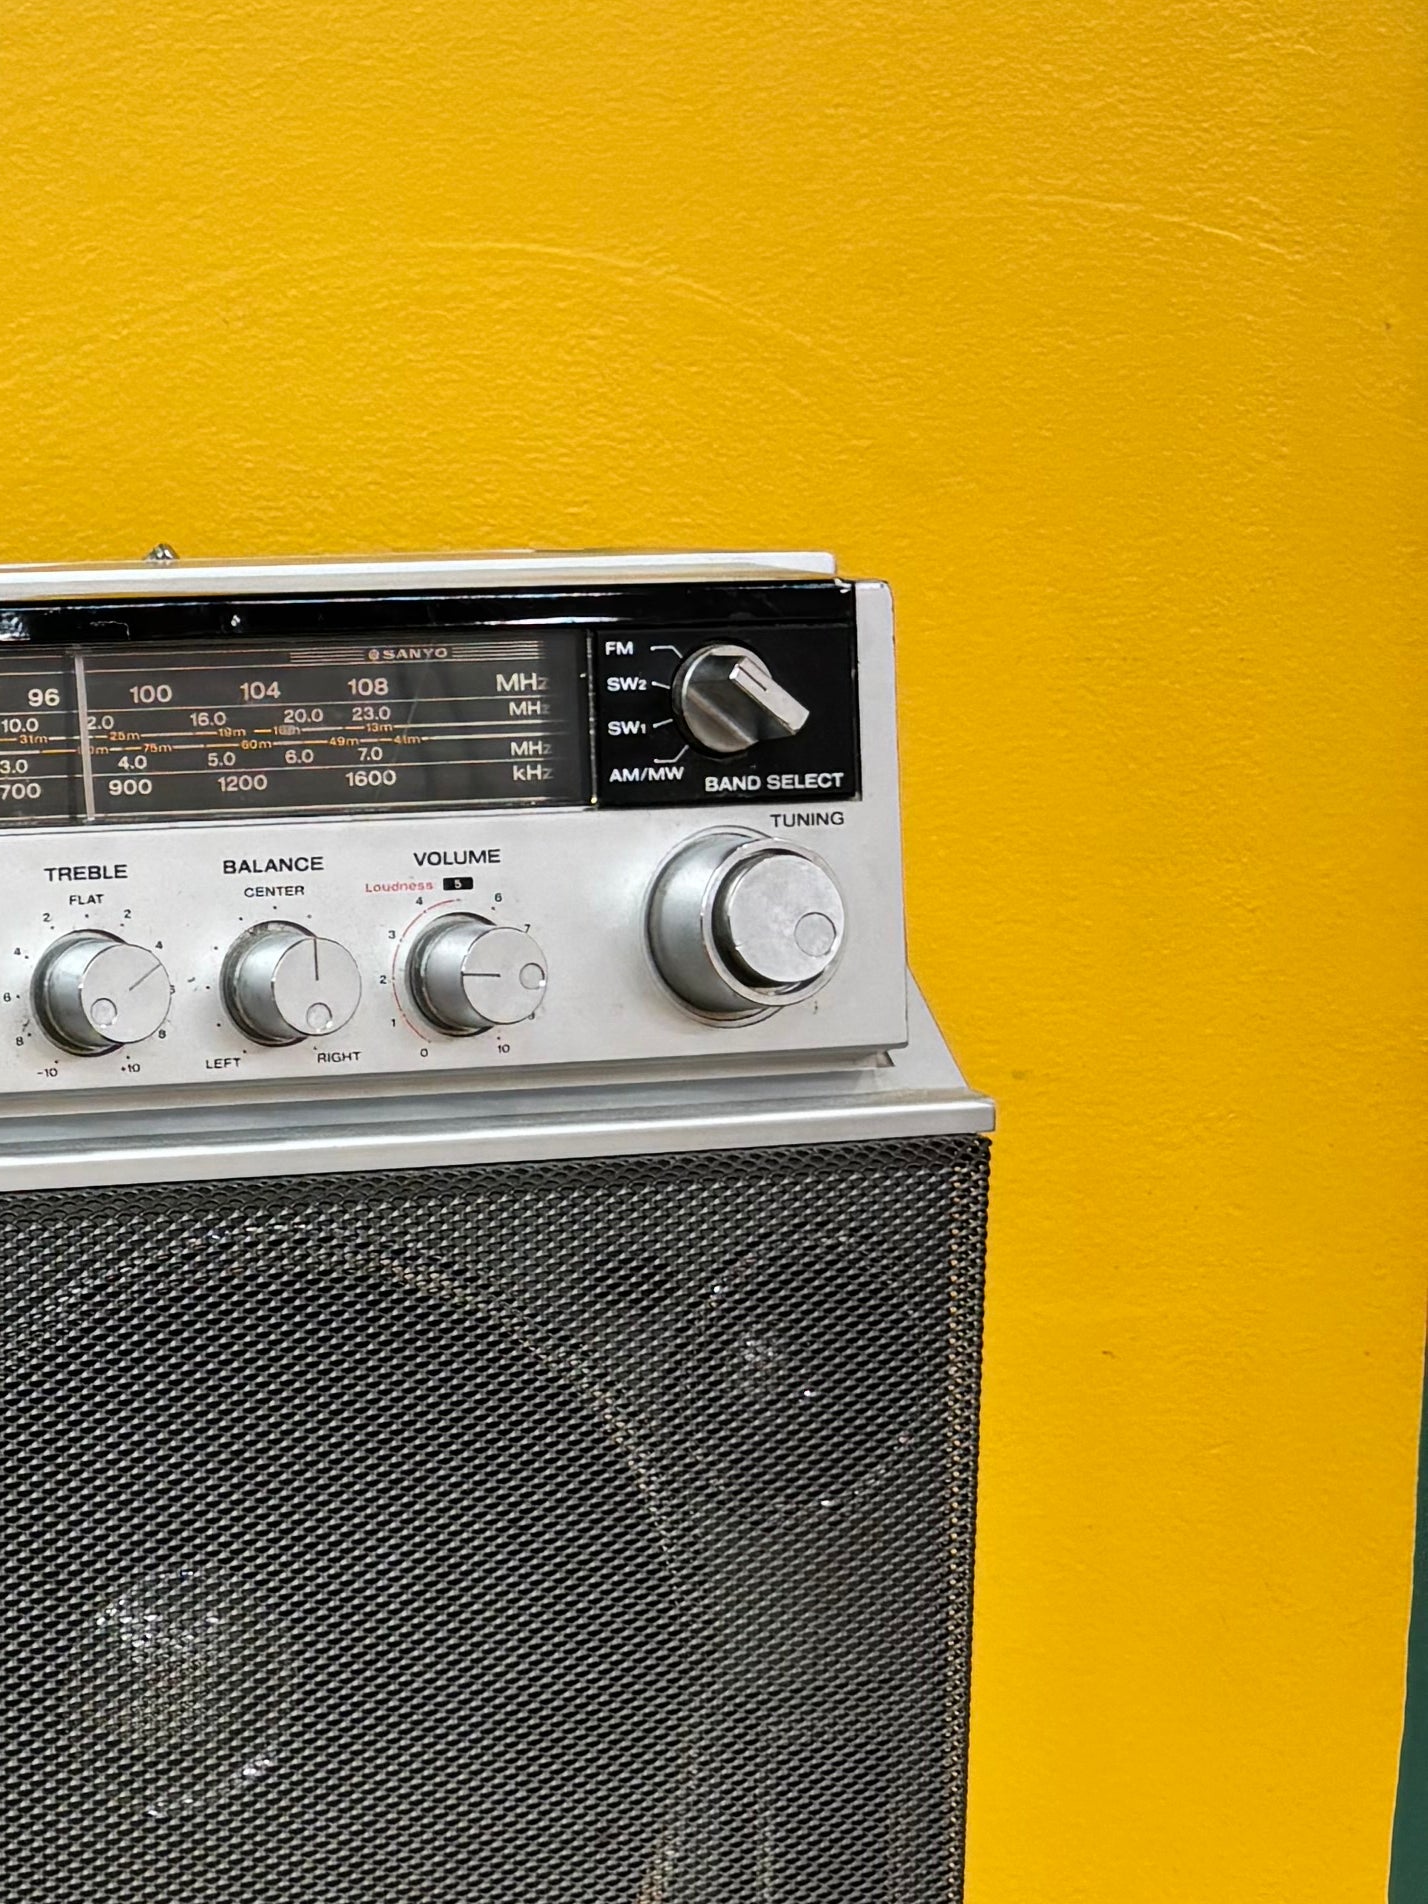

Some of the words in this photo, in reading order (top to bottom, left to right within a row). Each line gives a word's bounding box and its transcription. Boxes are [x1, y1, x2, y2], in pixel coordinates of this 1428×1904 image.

[383, 648, 447, 659] SANYO
[605, 642, 633, 655] FM
[28, 688, 60, 707] 96
[130, 684, 172, 703] 100
[240, 681, 280, 700] 104
[348, 678, 389, 695] 108
[496, 673, 549, 692] MHz
[1, 718, 39, 733] 10.0
[190, 711, 226, 726] 16.0
[284, 708, 323, 723] 20.0
[352, 706, 391, 721] 23.0
[366, 723, 393, 732] 13m
[0, 759, 28, 774] 3.0
[118, 755, 147, 769] 4.0
[208, 752, 235, 766] 5.0
[285, 749, 313, 764] 6.0
[359, 746, 383, 761] 7.0
[609, 767, 684, 782] AM/MW
[0, 783, 41, 800] 700
[109, 779, 152, 795] 900
[218, 775, 267, 792] 1200
[345, 769, 396, 786] 1600
[513, 765, 554, 781] kHz
[705, 776, 761, 791] BAND
[767, 773, 844, 789] SELECT
[771, 812, 844, 827] TUNING
[414, 849, 501, 867] VOLUME
[223, 856, 325, 874] BALANCE
[44, 864, 128, 882] TREBLE
[244, 886, 304, 898] CENTER
[365, 881, 434, 893] Loudness
[69, 894, 104, 907] FLAT
[415, 897, 423, 905] 4
[494, 893, 502, 902] 6
[43, 913, 51, 922] 2
[124, 909, 132, 919] 2
[388, 930, 396, 939] 3
[379, 975, 387, 984] 2
[3, 993, 12, 1002] 6
[16, 1036, 24, 1046] 8
[498, 1044, 510, 1054] 10
[206, 1057, 241, 1069] LEFT
[317, 1051, 362, 1063] RIGHT
[37, 1068, 58, 1077] -10
